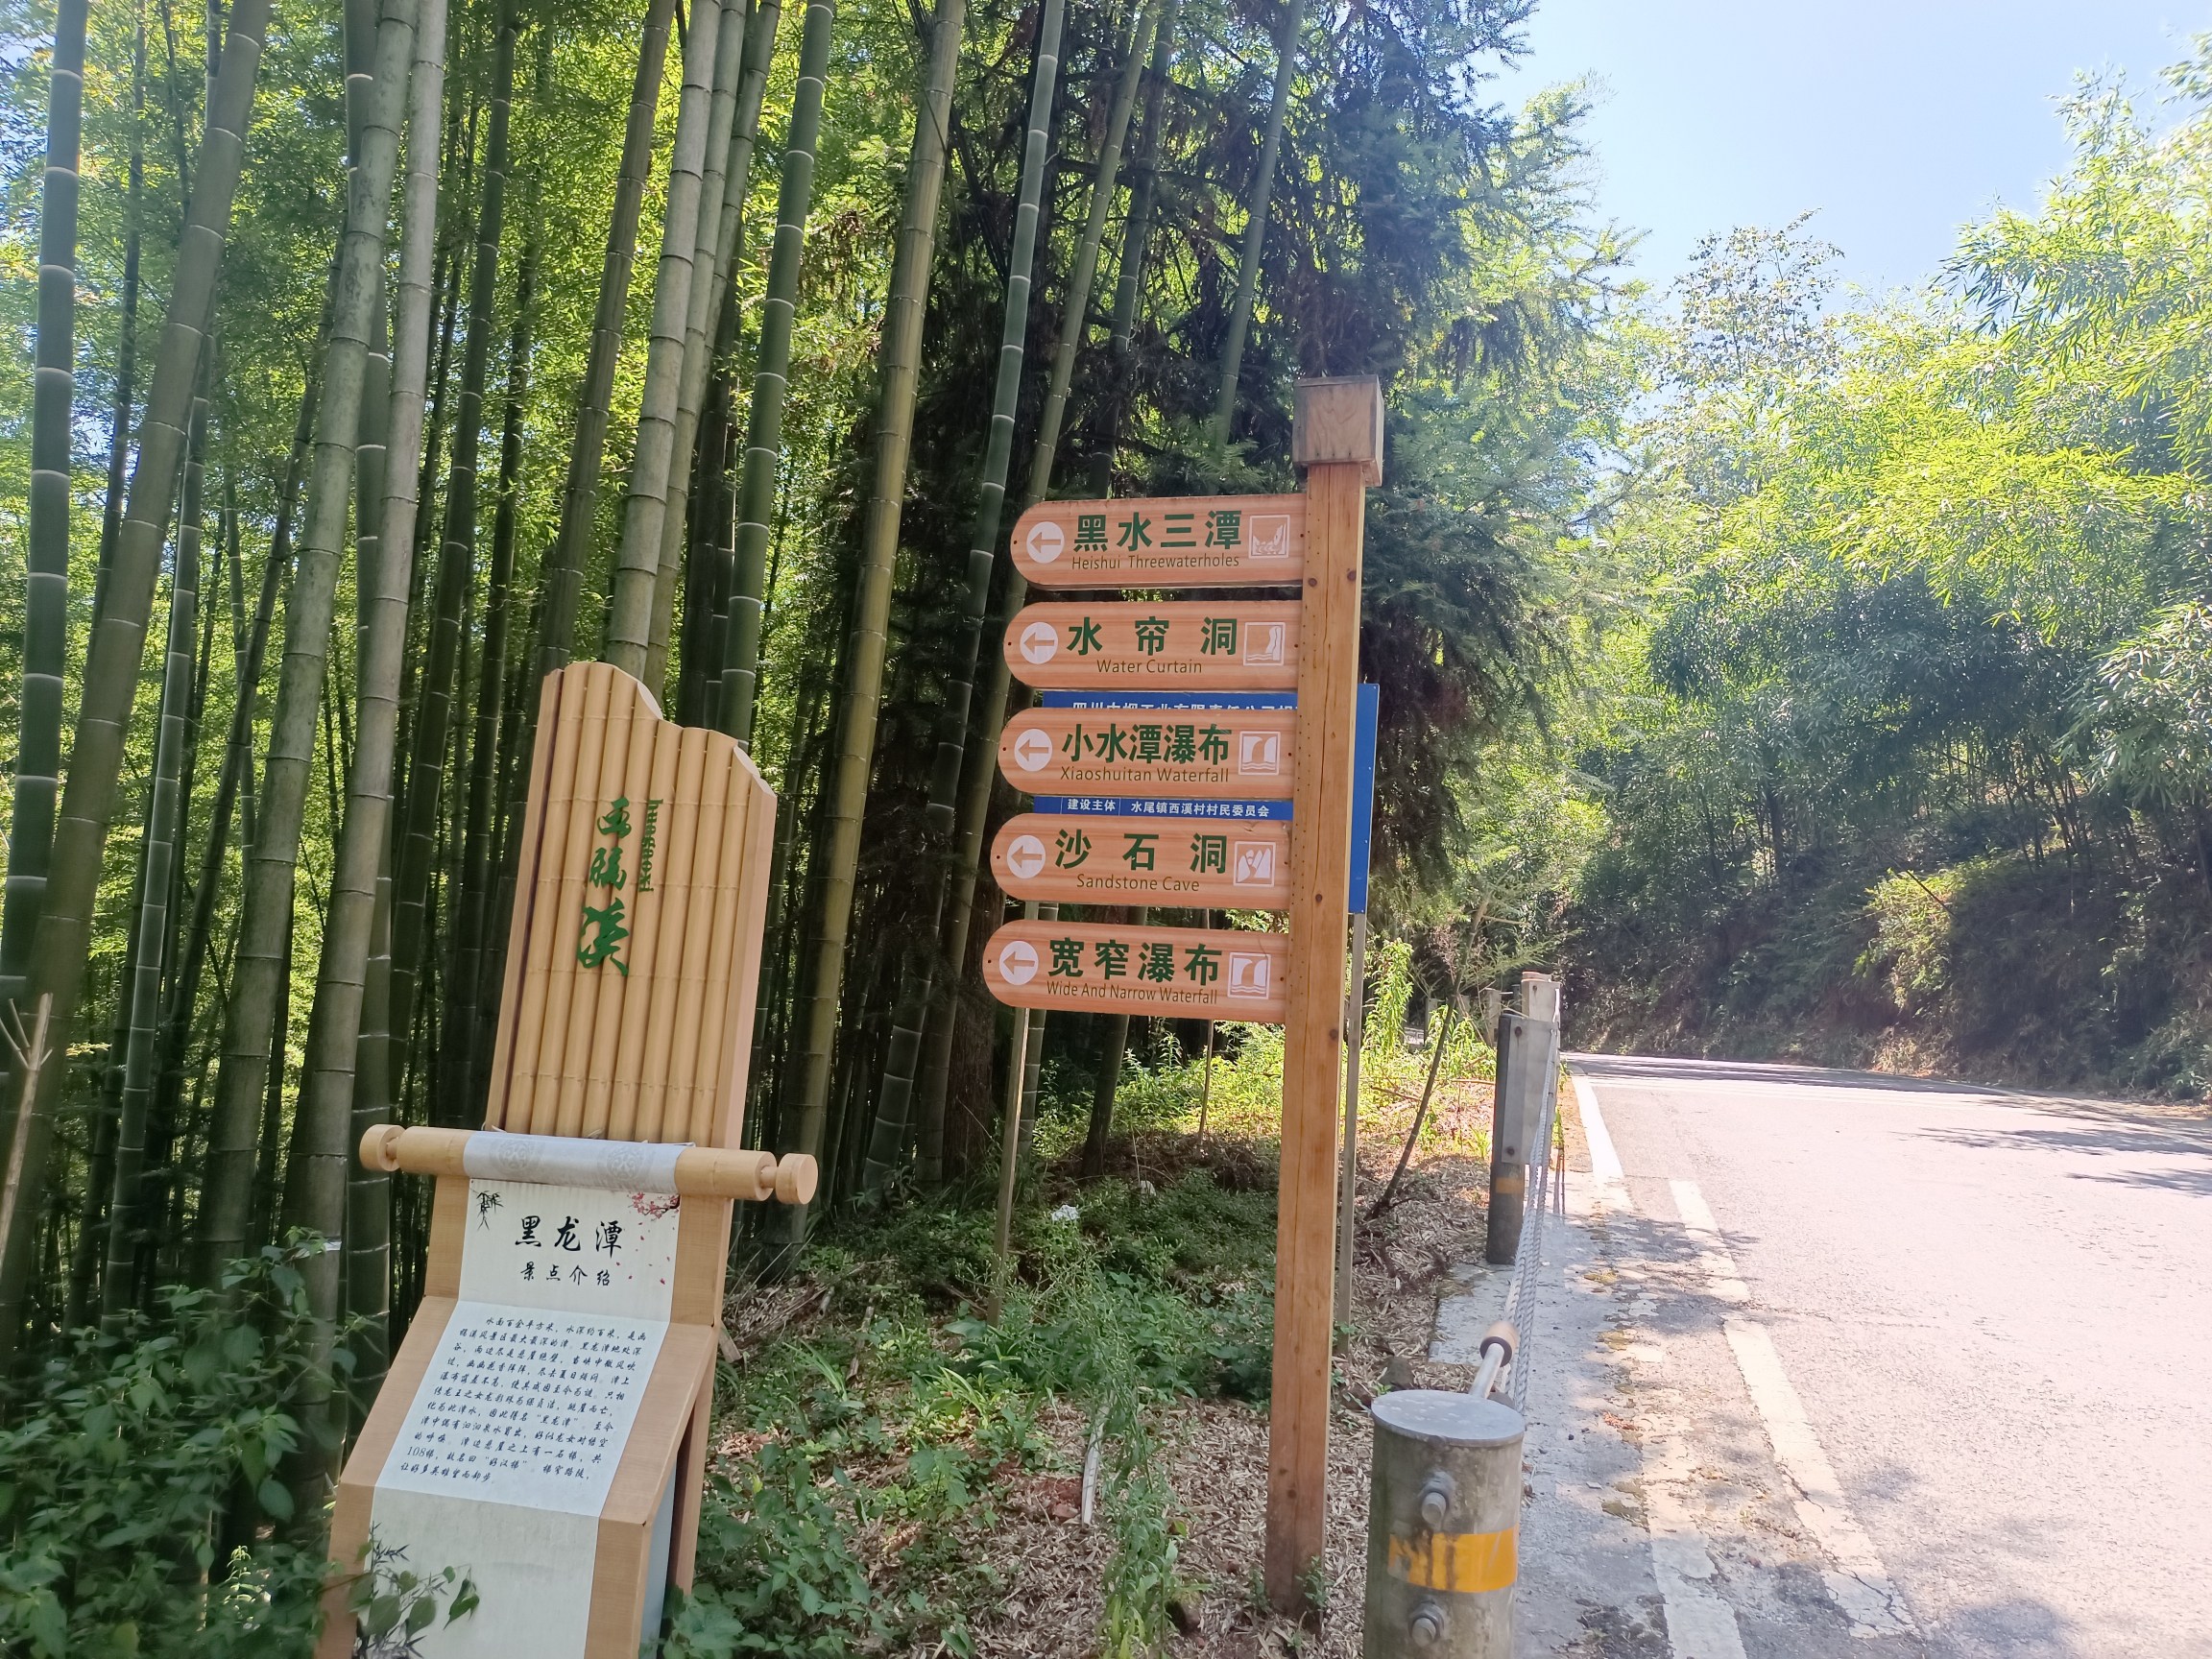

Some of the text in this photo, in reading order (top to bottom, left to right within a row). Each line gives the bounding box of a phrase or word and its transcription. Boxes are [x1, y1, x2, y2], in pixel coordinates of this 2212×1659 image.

[1073, 510, 1242, 552] 黑水三潭
[1072, 553, 1239, 570] Heishui Threewaterholes
[1067, 616, 1237, 656] 水帘洞
[1096, 660, 1202, 673] Water Curtain
[1062, 724, 1233, 765] 小水潭瀑布
[1060, 766, 1229, 783] Xiaoshuitan Waterfall
[1067, 798, 1270, 818] 建设主体 水尾镇西溪村村民委员会
[1055, 830, 1228, 874] 沙石洞
[1076, 874, 1200, 892] Sandstone Cave
[1047, 937, 1223, 986] 宽窄瀑布
[1046, 981, 1217, 1004] Wide And Narrow Waterfall
[515, 1215, 623, 1258] 黑龙潭
[521, 1262, 610, 1286] 景点介绍
